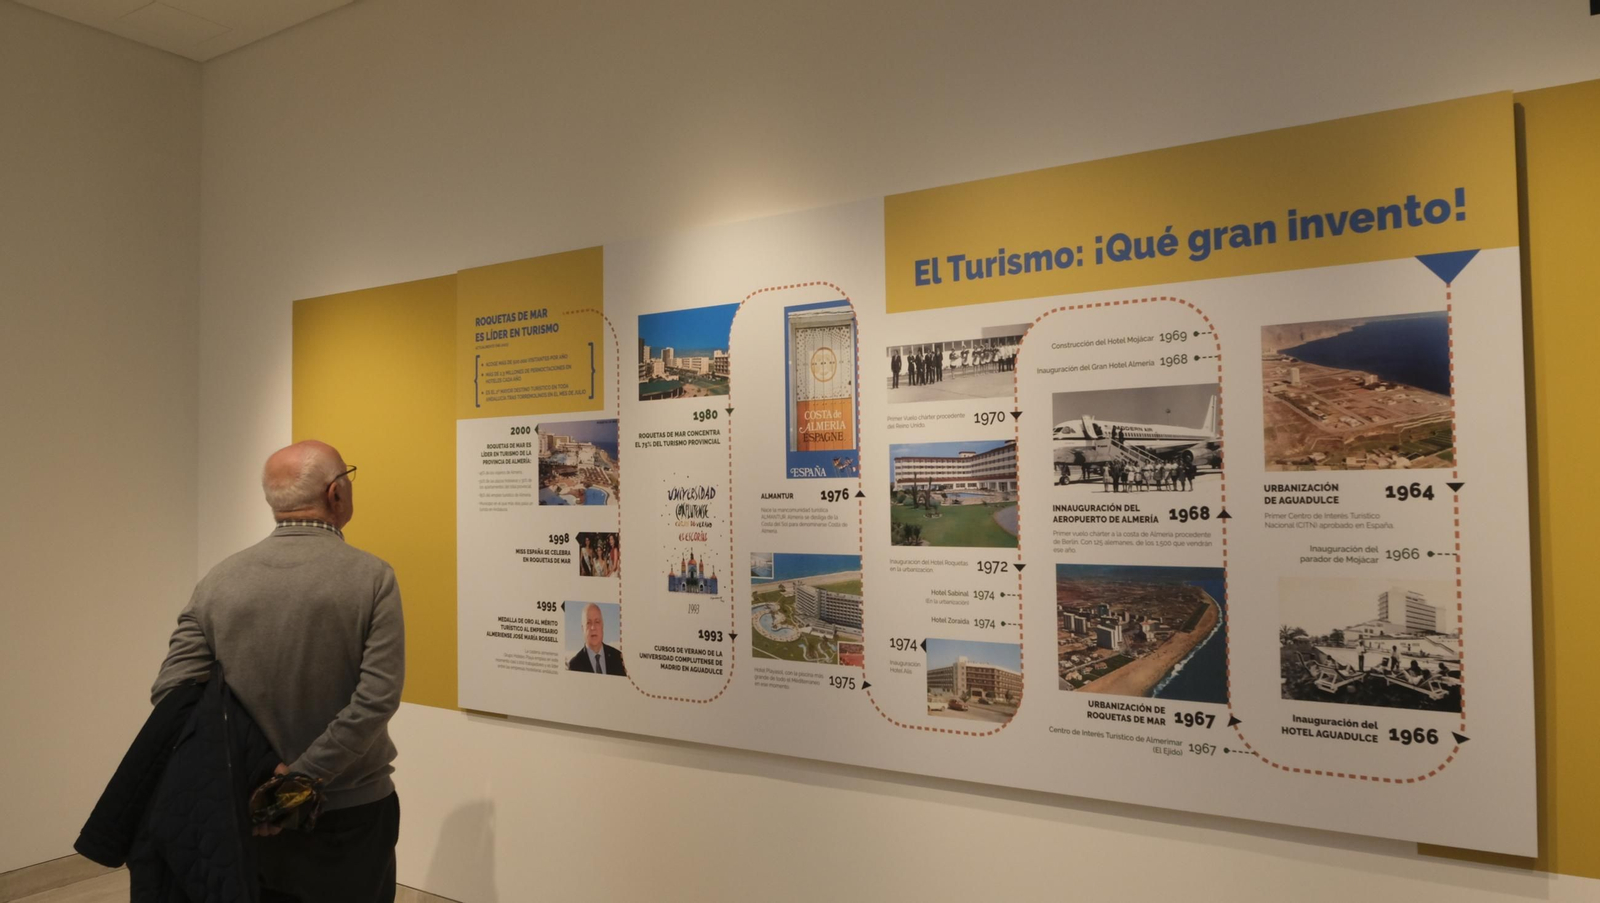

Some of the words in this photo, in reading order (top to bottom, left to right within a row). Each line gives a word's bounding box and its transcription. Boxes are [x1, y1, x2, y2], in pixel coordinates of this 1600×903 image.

[914, 256, 942, 287] El
[947, 244, 1084, 282] Turismo:
[1094, 225, 1179, 266] ¡Qué
[1188, 213, 1277, 262] gran
[1288, 187, 1467, 243] invento!
[475, 313, 516, 326] ROQUETAS
[518, 311, 528, 321] DE
[530, 308, 548, 319] MAR
[475, 333, 484, 342] ES
[486, 328, 508, 341] LÍDER
[510, 328, 520, 338] EN
[522, 323, 559, 336] TURISMO
[1159, 330, 1188, 343] 1969
[1051, 340, 1094, 350] Construcción
[1127, 335, 1154, 344] Mojácar
[1160, 354, 1188, 367] 1968
[693, 409, 718, 422] 1980
[804, 410, 832, 420] COSTA
[974, 411, 1005, 426] 1970
[510, 426, 531, 435] 2000
[803, 432, 844, 443] ESPAGNE
[790, 465, 826, 477] ESPAÑA
[1264, 482, 1339, 492] URBANIZACIÓN
[1385, 482, 1434, 501] 1964
[820, 488, 849, 502] 1976
[1278, 496, 1339, 504] AGUADULCE
[1053, 503, 1122, 512] INNAUGURACIÓN
[1122, 514, 1159, 523] ALMERÍA
[1169, 506, 1210, 523] 1968
[549, 533, 569, 545] 1998
[1310, 545, 1363, 553] Inauguración
[1386, 548, 1420, 561] 1966
[1300, 556, 1331, 564] parador
[977, 561, 1008, 574] 1972
[973, 591, 995, 600] 1974
[537, 601, 556, 612] 1995
[974, 619, 995, 629] 1974
[698, 630, 723, 642] 1993
[889, 638, 917, 651] 1974
[639, 653, 674, 661] UNIVERSIDAD
[675, 656, 714, 665] COMPLUTENSE
[690, 666, 723, 675] AGUADULCE
[829, 676, 855, 690] 1975
[1088, 700, 1152, 713] URBANIZACIÓN
[1154, 705, 1166, 714] DE
[1087, 711, 1132, 722] ROQUETAS
[1147, 717, 1166, 726] MAR
[1174, 711, 1216, 729] 1967
[1293, 714, 1359, 728] Inauguración
[1361, 720, 1378, 729] del
[1049, 726, 1071, 734] Centro
[1146, 736, 1182, 746] Almerimar
[1282, 726, 1314, 737] HOTEL
[1316, 729, 1378, 743] AGUADULCE
[1389, 728, 1439, 745] 1966
[1163, 748, 1183, 756] Ejido)
[1188, 743, 1216, 756] 1967
